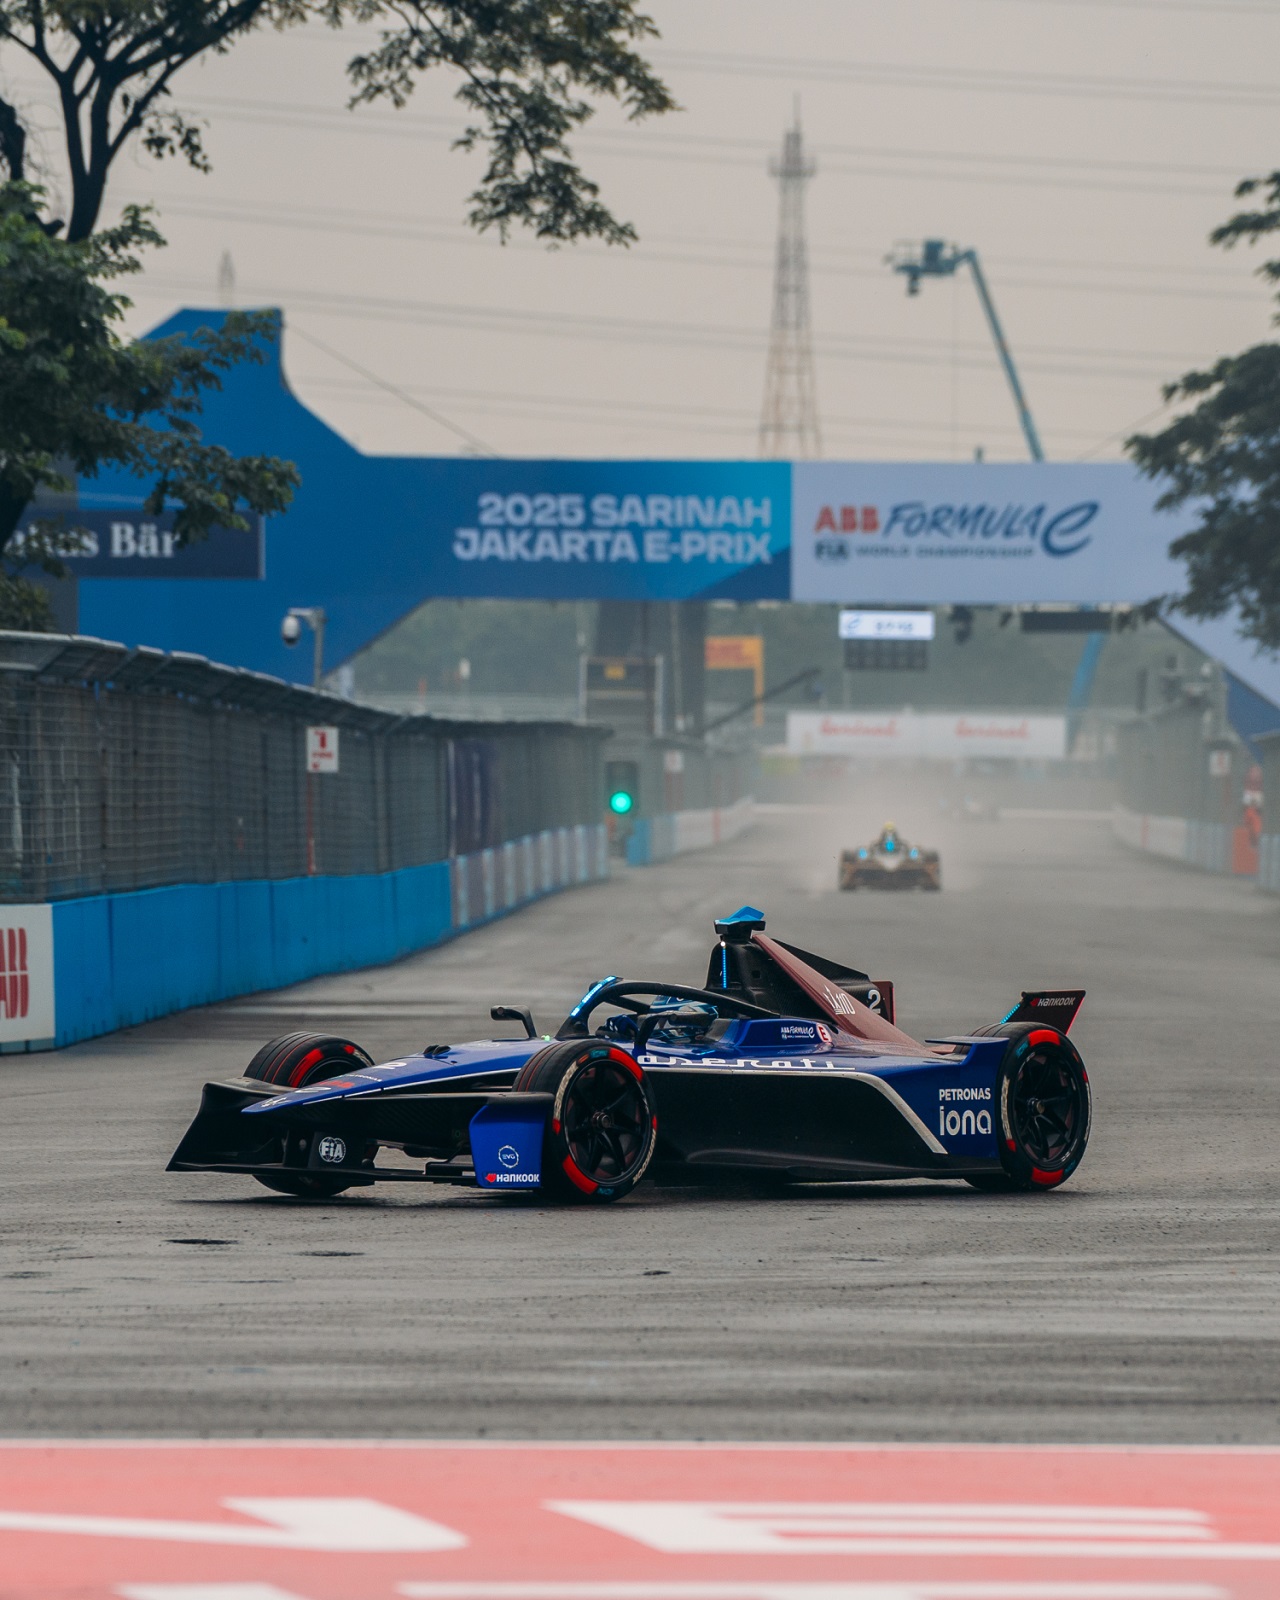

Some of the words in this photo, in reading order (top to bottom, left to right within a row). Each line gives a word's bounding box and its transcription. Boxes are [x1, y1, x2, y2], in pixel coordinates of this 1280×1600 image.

[477, 492, 586, 527] 2025
[590, 493, 772, 528] SARINAH
[814, 505, 880, 534] ABB
[883, 500, 1047, 539] FORMULA
[109, 521, 181, 558] Bär
[453, 528, 639, 562] JAKARTA
[642, 530, 773, 564] E-PRIX
[868, 989, 881, 1014] 2
[818, 1026, 829, 1041] E
[637, 1055, 854, 1070] aserati
[939, 1088, 991, 1101] PETRONAS
[939, 1105, 992, 1136] iona
